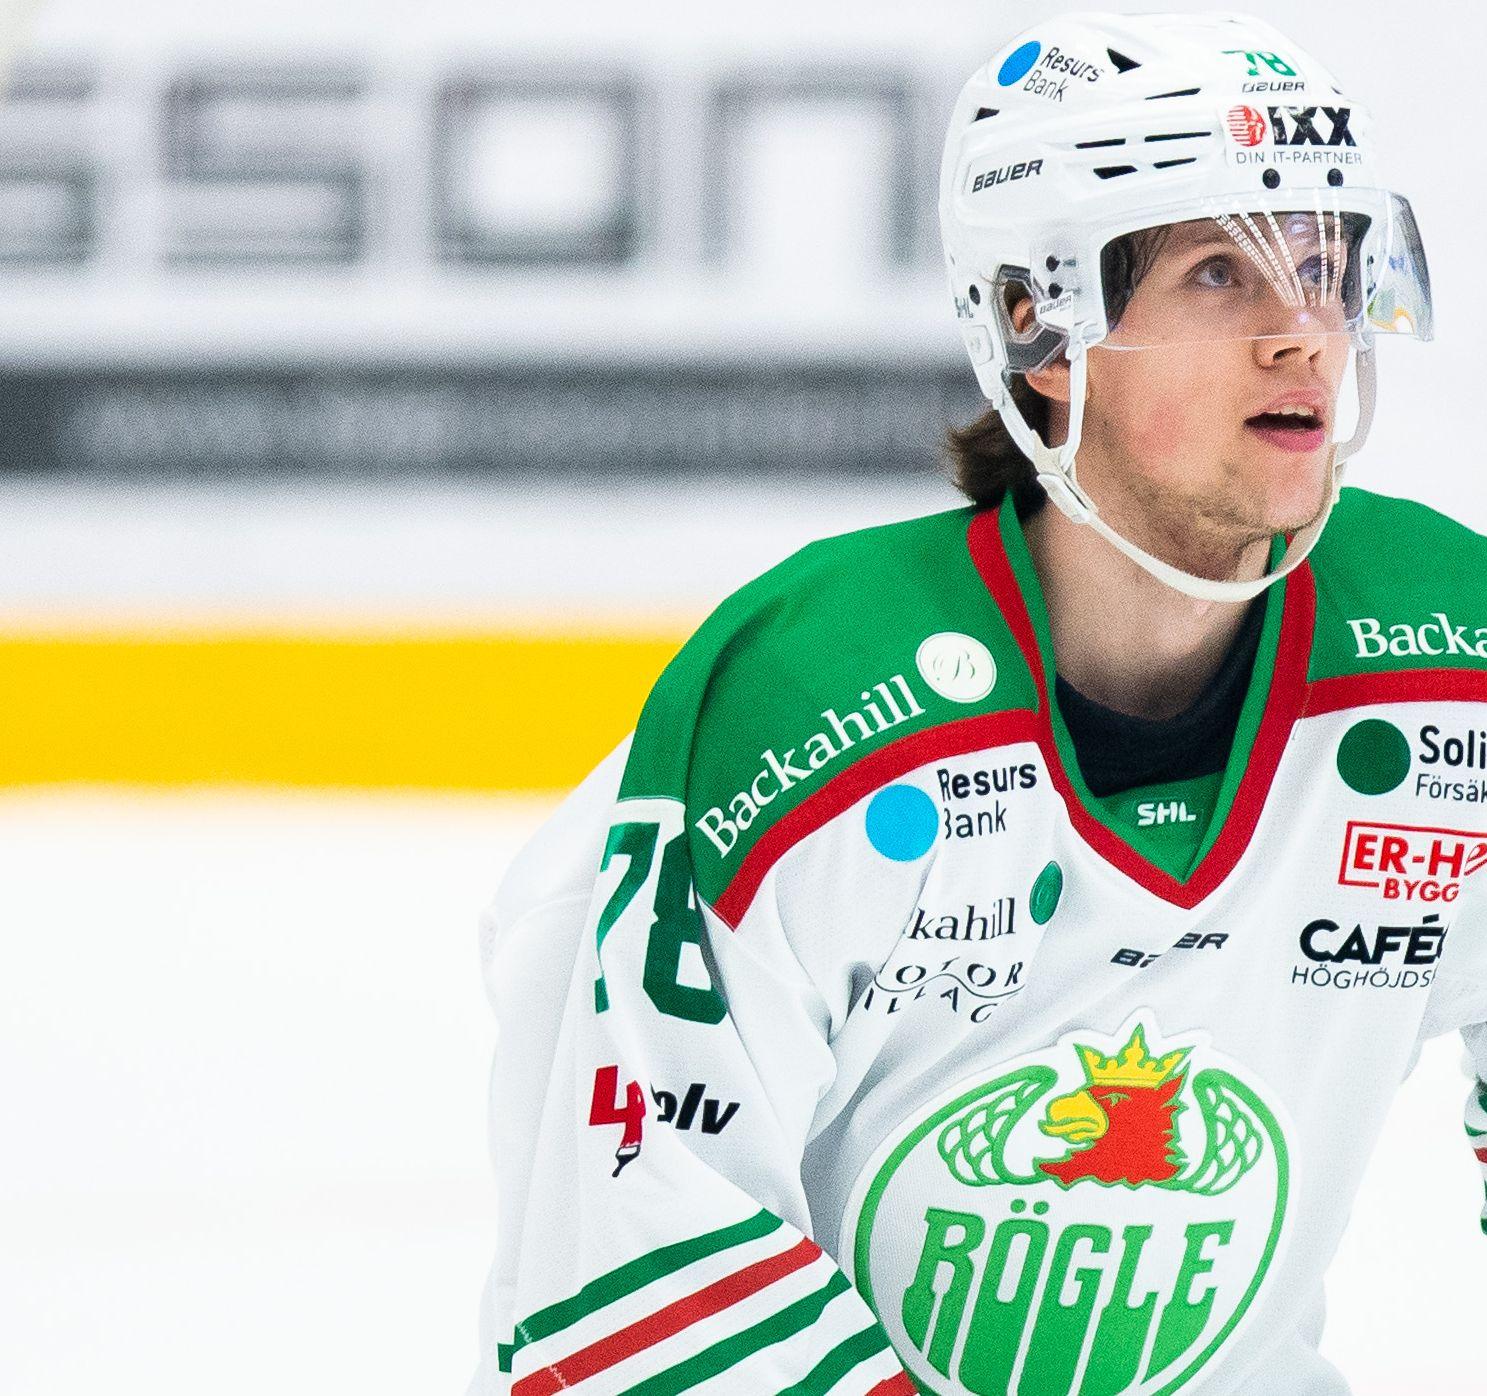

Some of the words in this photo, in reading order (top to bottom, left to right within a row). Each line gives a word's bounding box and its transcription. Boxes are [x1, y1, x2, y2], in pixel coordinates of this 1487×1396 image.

[1040, 46, 1102, 83] Resurs
[1222, 50, 1297, 77] 78
[1023, 69, 1069, 102] Bank
[971, 158, 1045, 194] BAUER
[1236, 151, 1265, 165] DIN
[1273, 150, 1363, 166] IT-PARTNER
[694, 673, 927, 860] Backahill
[936, 762, 1038, 803] Resurs
[1137, 801, 1197, 827] SHL
[1382, 877, 1460, 903] BYGG
[594, 821, 729, 1026] 78
[1299, 913, 1449, 965] CAFÉ
[1291, 963, 1437, 990] HÖGHÖJDS
[901, 1198, 1236, 1370] RÖGLE
